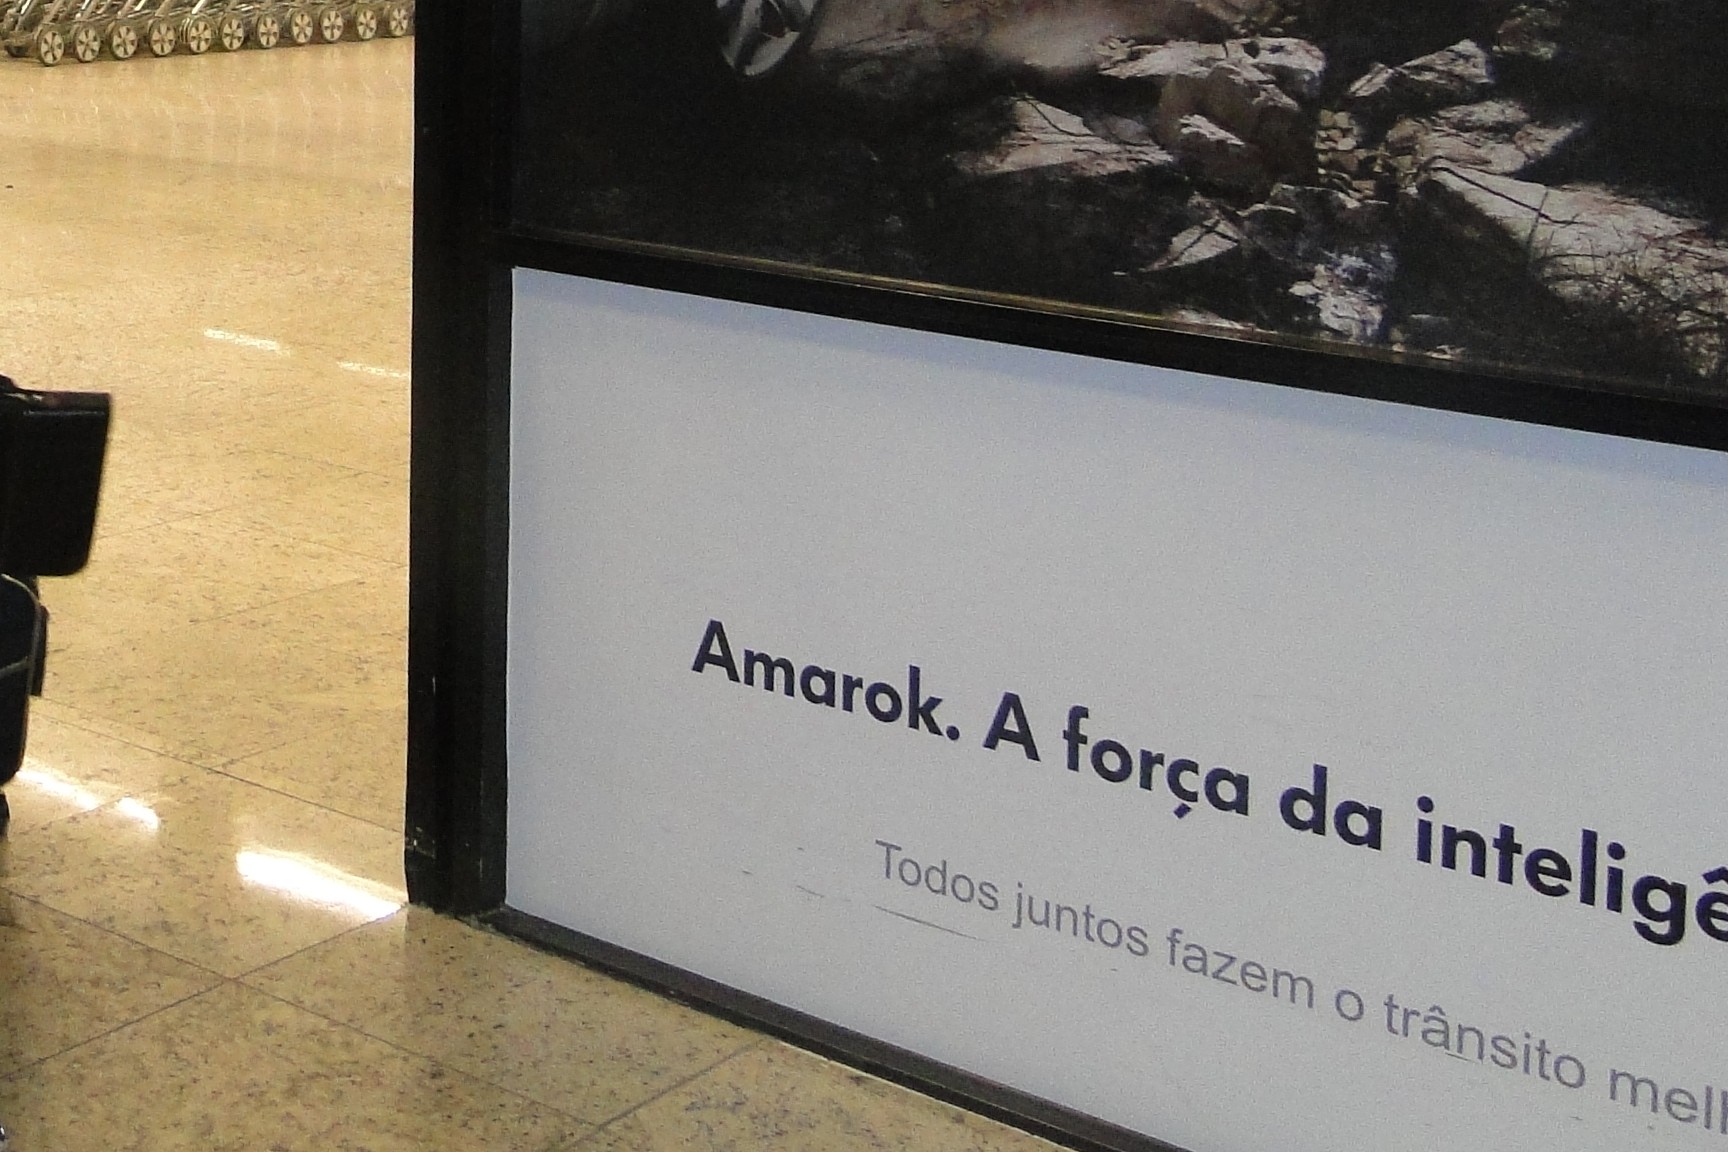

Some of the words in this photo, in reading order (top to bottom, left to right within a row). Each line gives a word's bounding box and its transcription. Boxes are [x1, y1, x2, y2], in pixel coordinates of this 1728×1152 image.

[691, 619, 961, 742] Amarok.
[983, 691, 1042, 763] A
[1063, 705, 1250, 820] força
[1278, 764, 1383, 852] da
[875, 839, 999, 912] Todos
[1011, 878, 1150, 957] juntos
[1166, 928, 1315, 1010] fazem
[1334, 989, 1365, 1023] o
[1384, 994, 1587, 1090] trânsito
[1609, 1068, 1728, 1135] mel
